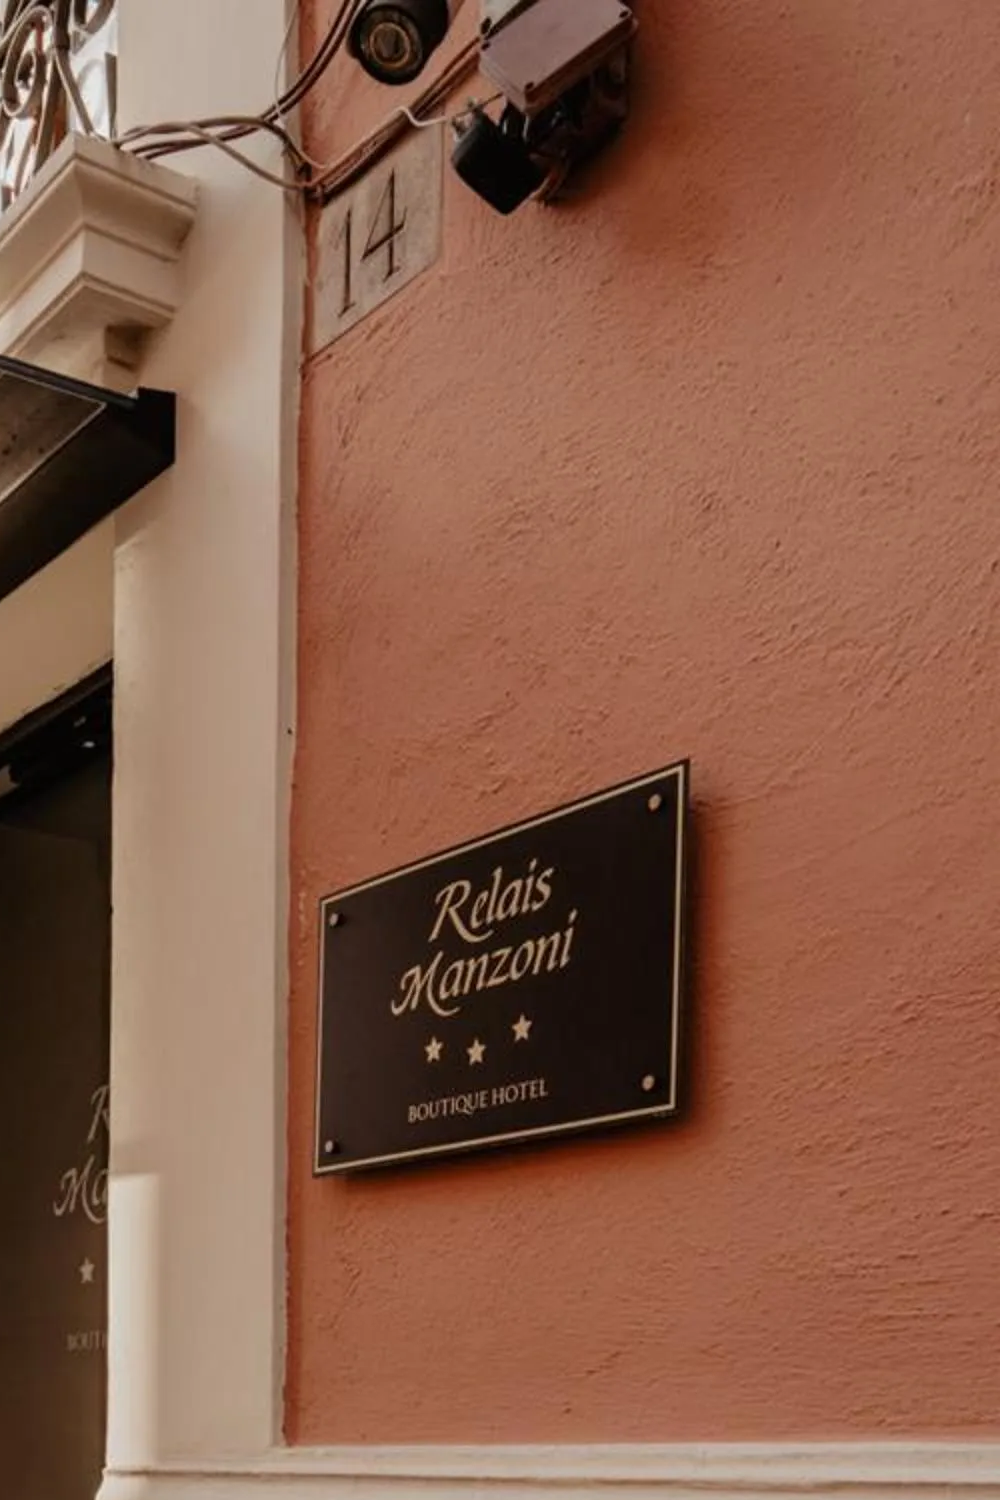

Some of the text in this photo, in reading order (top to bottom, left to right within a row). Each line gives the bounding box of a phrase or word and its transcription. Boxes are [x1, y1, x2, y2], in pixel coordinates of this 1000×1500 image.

[337, 168, 408, 318] 14
[428, 858, 555, 943] Relais
[391, 909, 578, 1017] Manzoni
[408, 1079, 549, 1123] BOUTIQUE HOTEL
